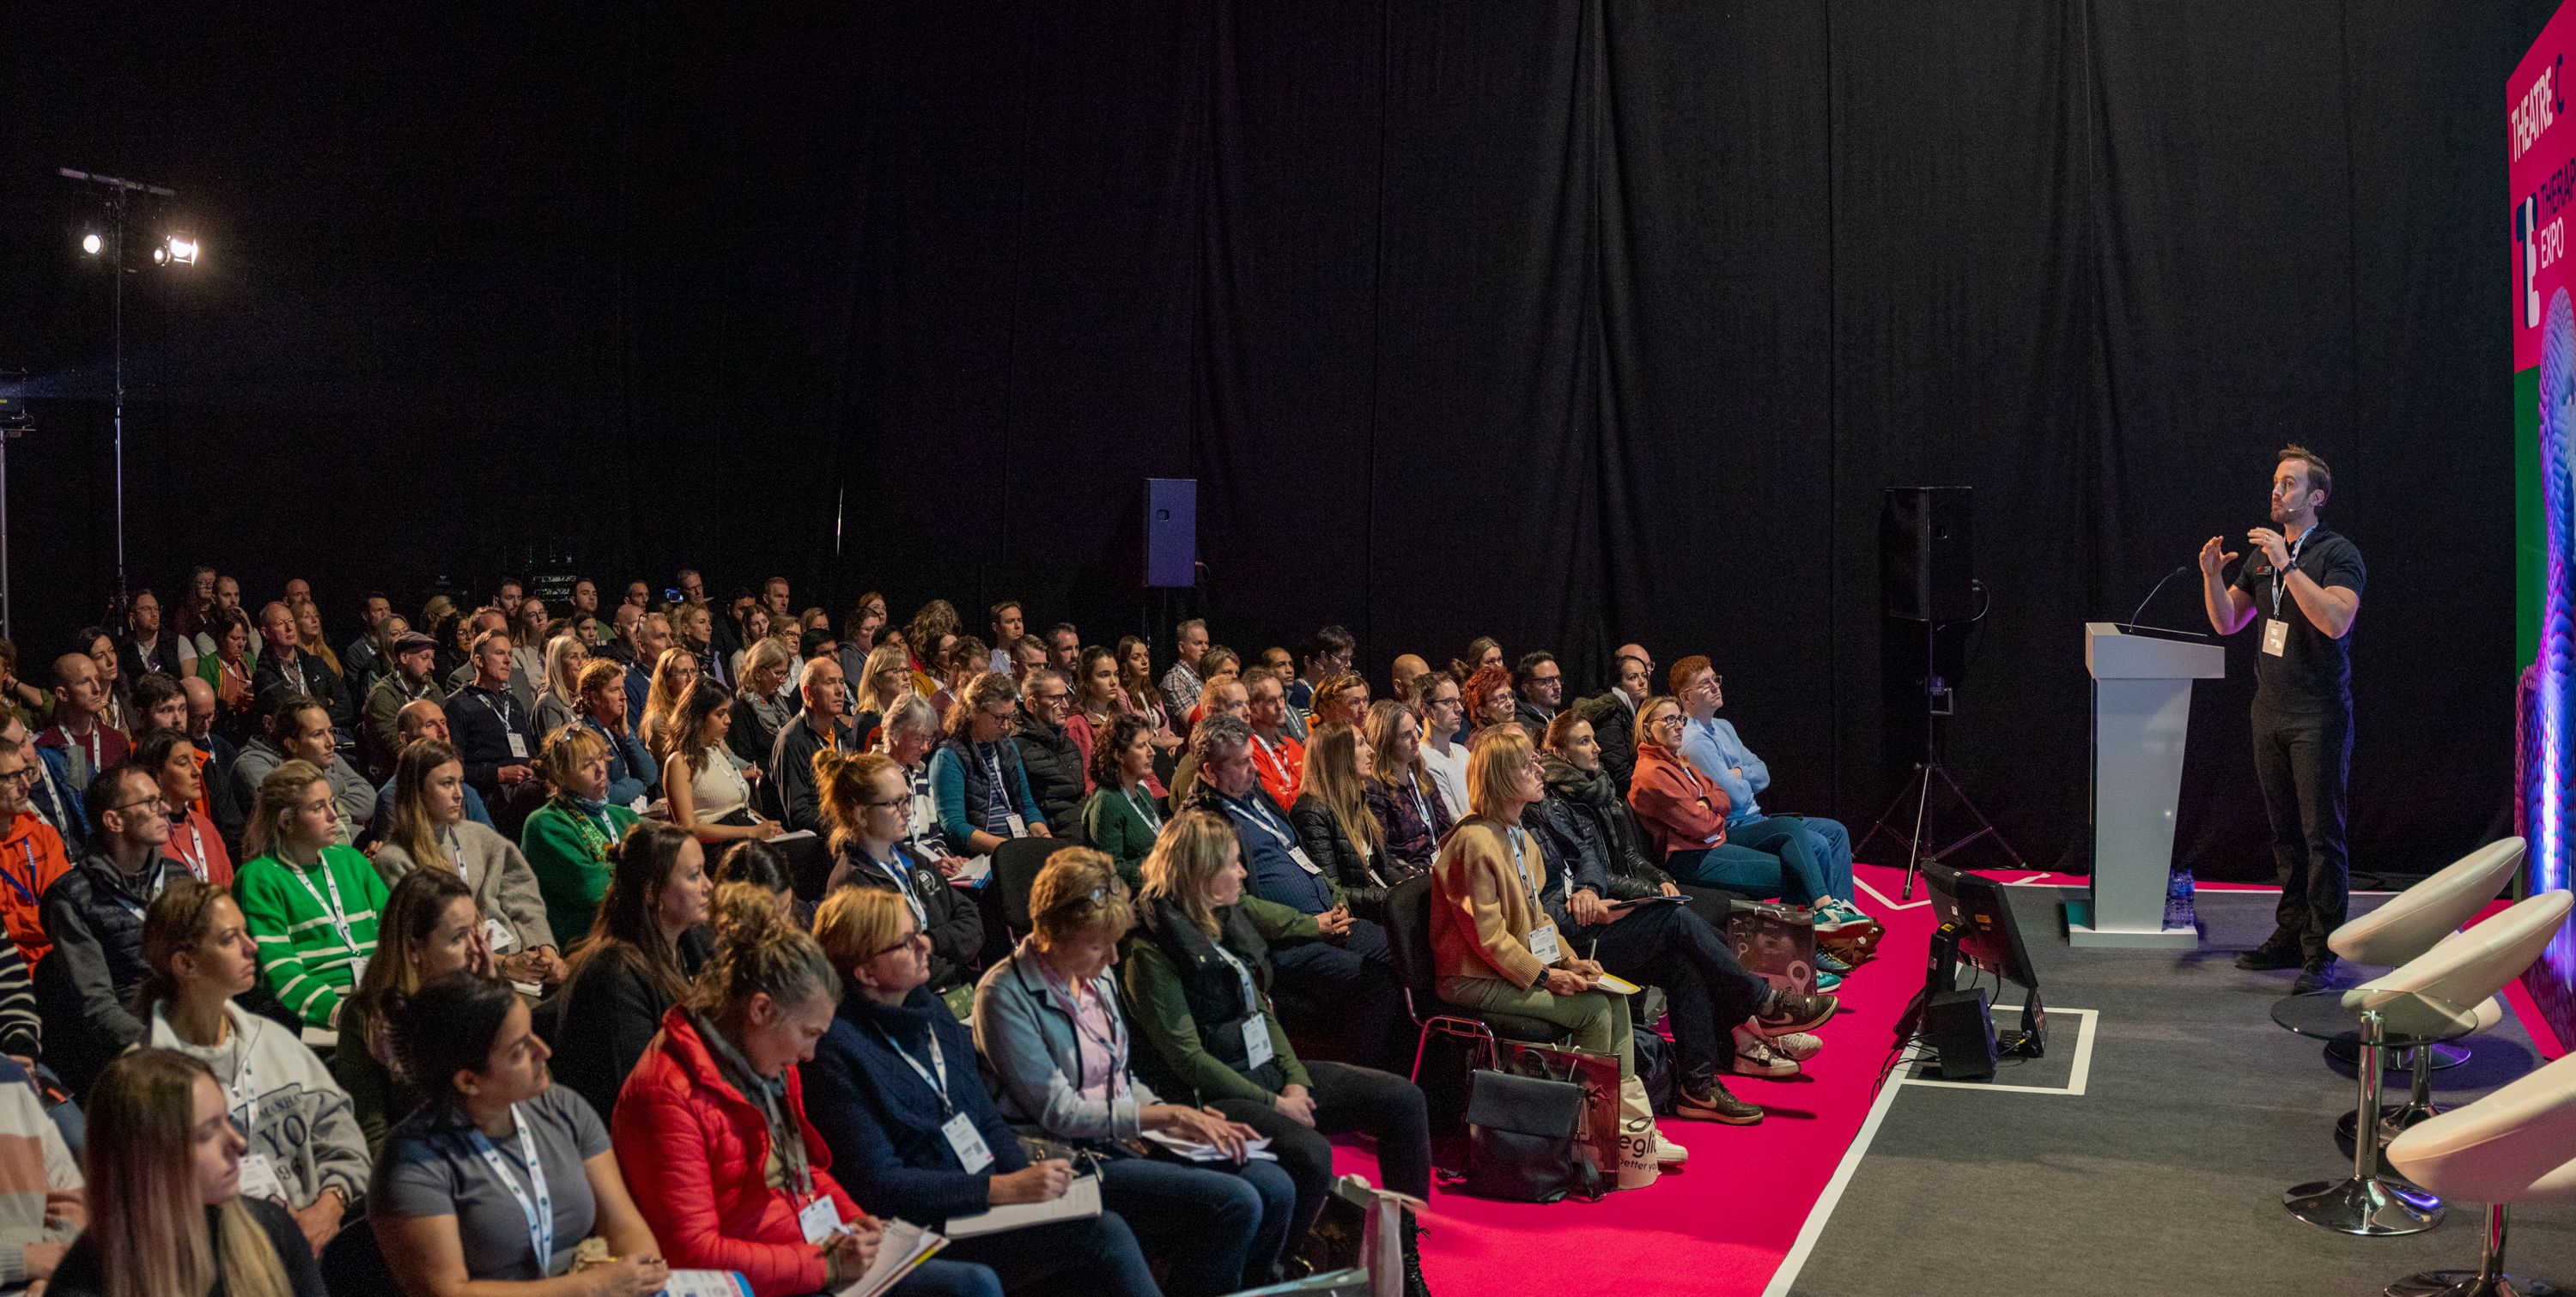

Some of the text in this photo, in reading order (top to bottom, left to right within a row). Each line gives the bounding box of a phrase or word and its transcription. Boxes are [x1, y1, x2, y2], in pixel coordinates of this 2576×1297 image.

[2512, 52, 2565, 163] THEATRE C
[2541, 216, 2564, 270] EXPO
